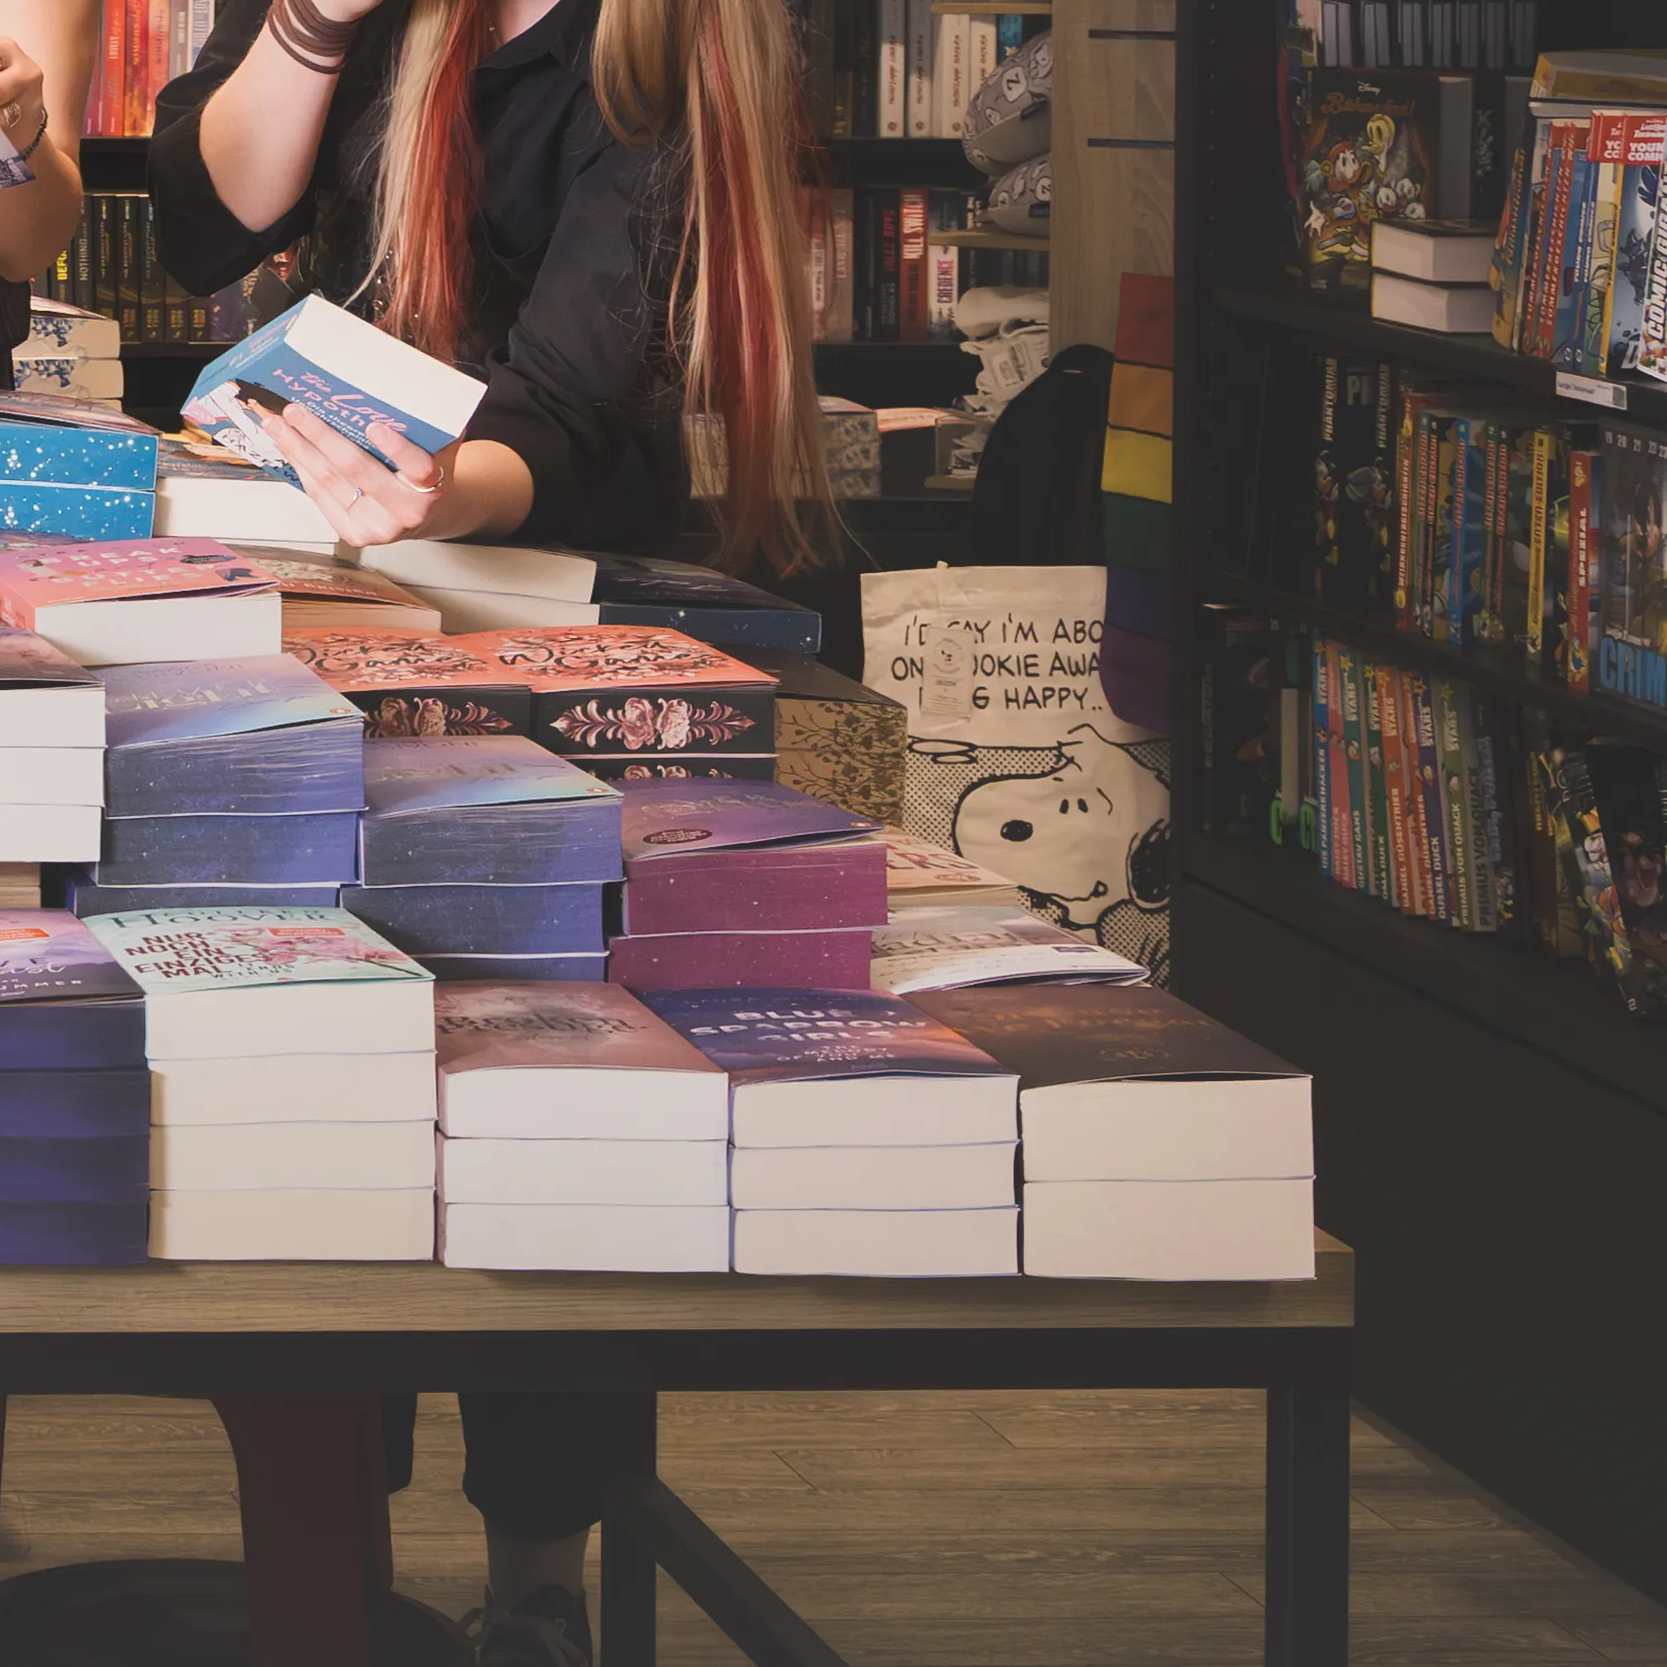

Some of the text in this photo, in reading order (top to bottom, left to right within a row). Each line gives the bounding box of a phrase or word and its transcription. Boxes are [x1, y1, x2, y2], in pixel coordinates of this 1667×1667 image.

[330, 392, 409, 434] Love
[891, 656, 924, 681] ON
[141, 932, 206, 945] NUR
[124, 940, 210, 957] NOCH
[173, 948, 228, 960] EIN
[133, 954, 272, 974] EINZIGES
[161, 967, 231, 979] MAL
